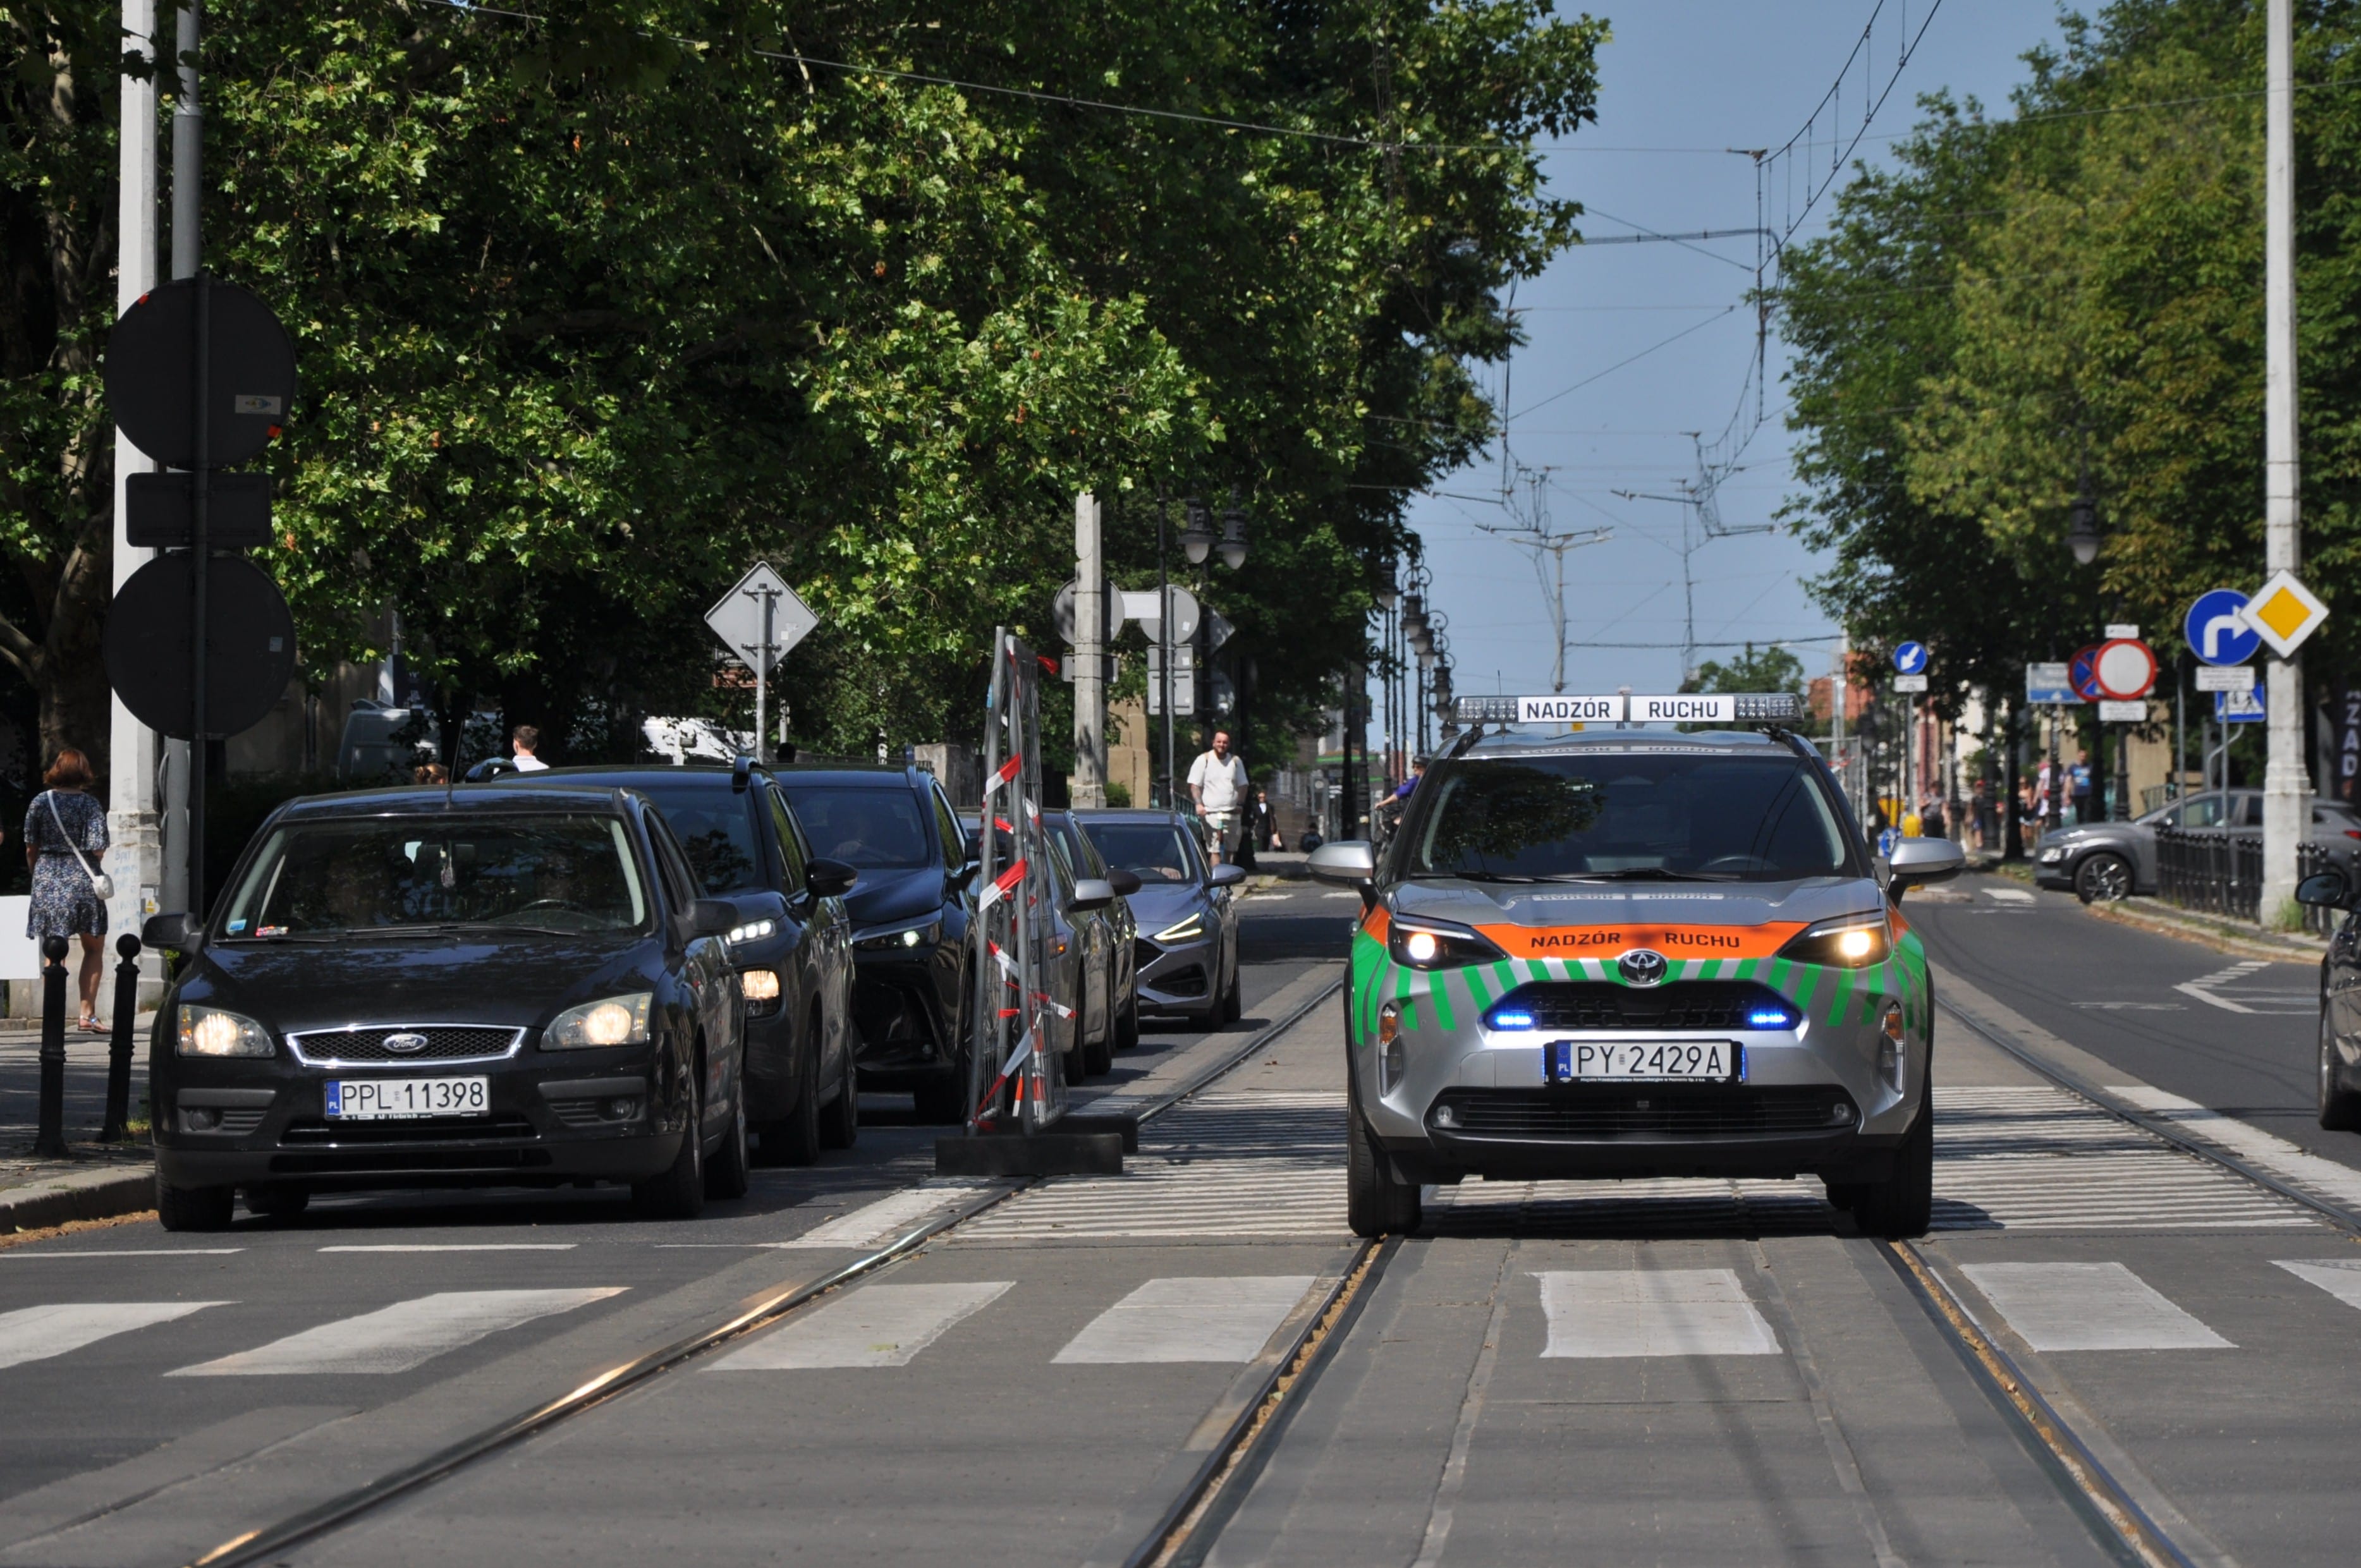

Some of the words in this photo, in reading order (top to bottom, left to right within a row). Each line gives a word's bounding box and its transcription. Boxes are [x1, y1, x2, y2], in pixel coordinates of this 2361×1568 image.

[1527, 698, 1611, 719] NADZÓR
[1649, 702, 1718, 718] RUCHU
[1532, 931, 1621, 947] NADZÓR
[1665, 933, 1740, 947] RUCHU
[393, 1037, 417, 1048] Ford
[1558, 1064, 1569, 1072] PL
[1578, 1046, 1615, 1073] PY
[1629, 1046, 1722, 1073] 2429A
[342, 1085, 392, 1110] PPL
[405, 1082, 484, 1109] 11398
